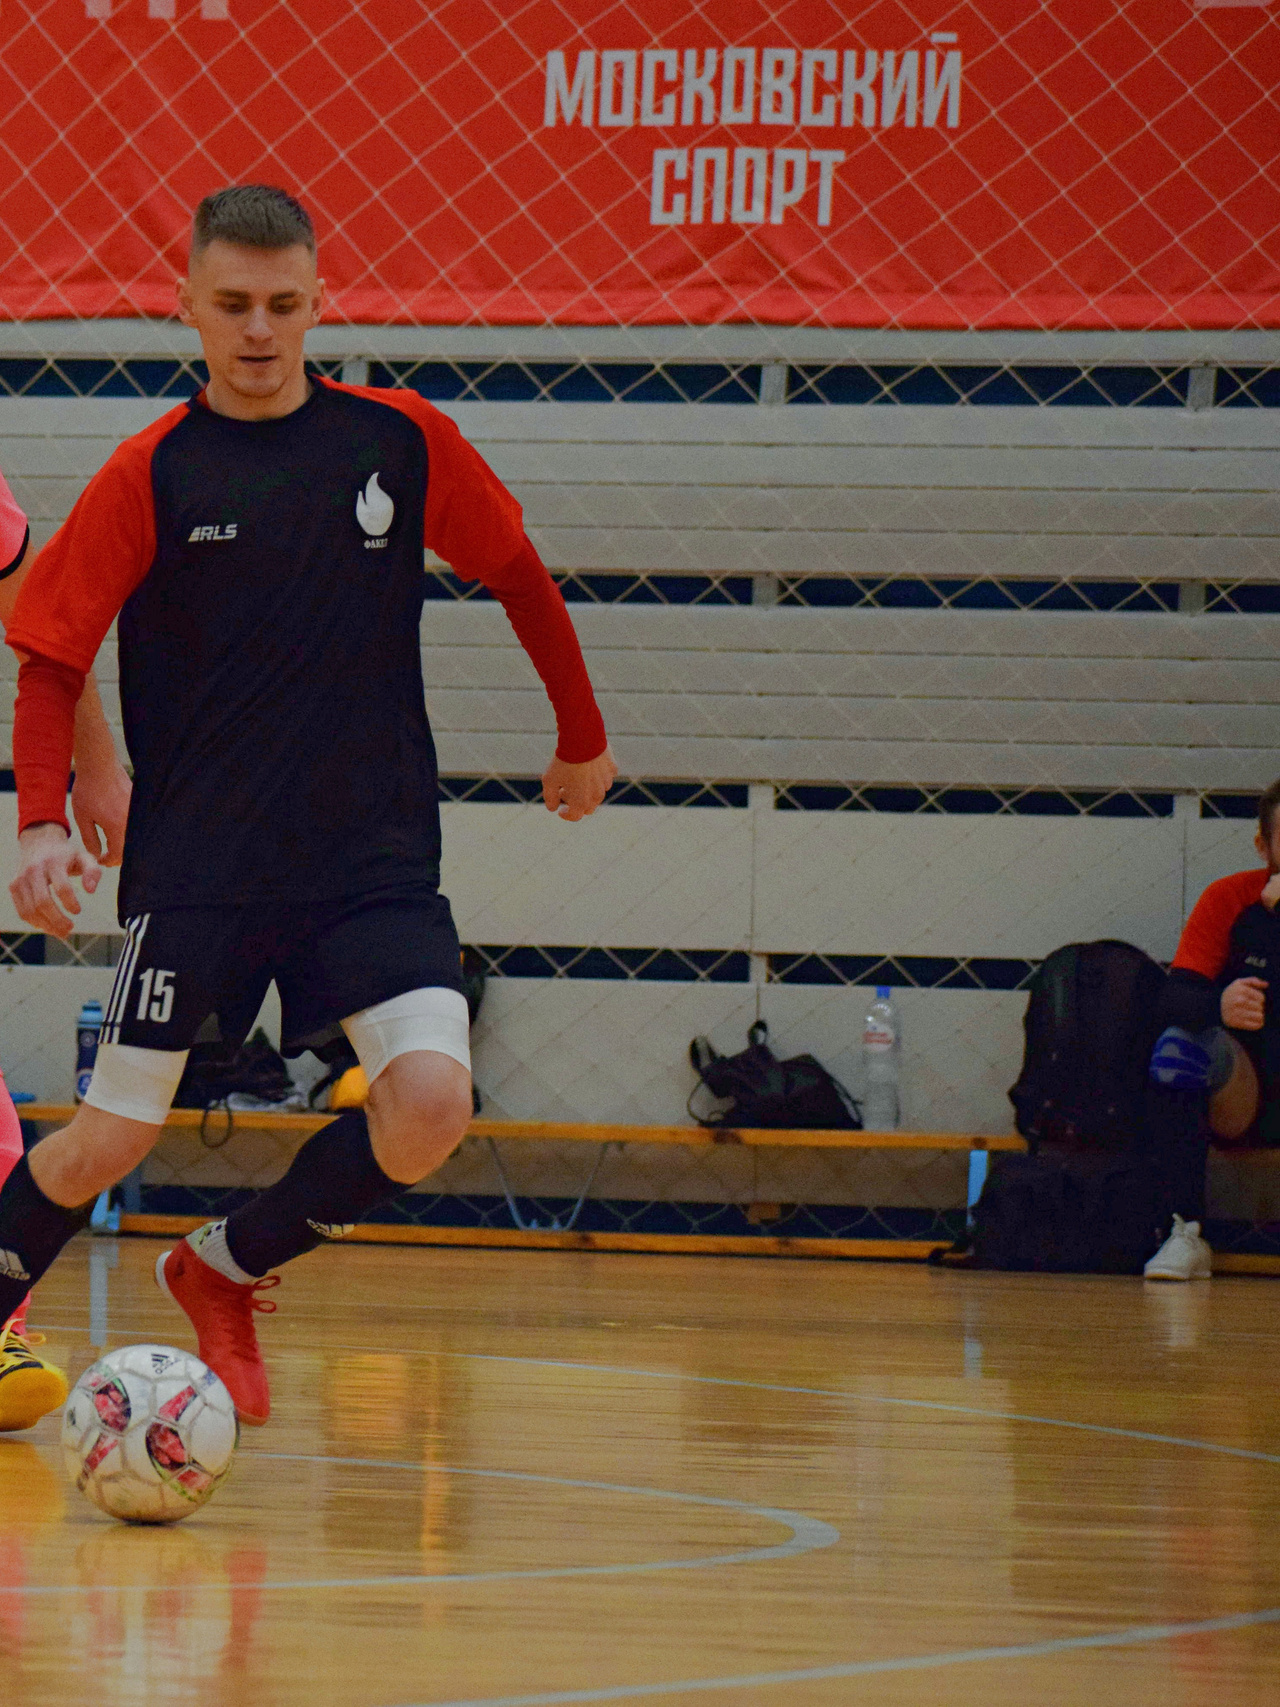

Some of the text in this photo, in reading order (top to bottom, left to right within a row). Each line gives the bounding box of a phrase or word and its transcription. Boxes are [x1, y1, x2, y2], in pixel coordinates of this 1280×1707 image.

[543, 32, 962, 128] МОСКОВСКИЙ
[650, 147, 846, 226] СПОРТ
[136, 967, 176, 1023] 15
